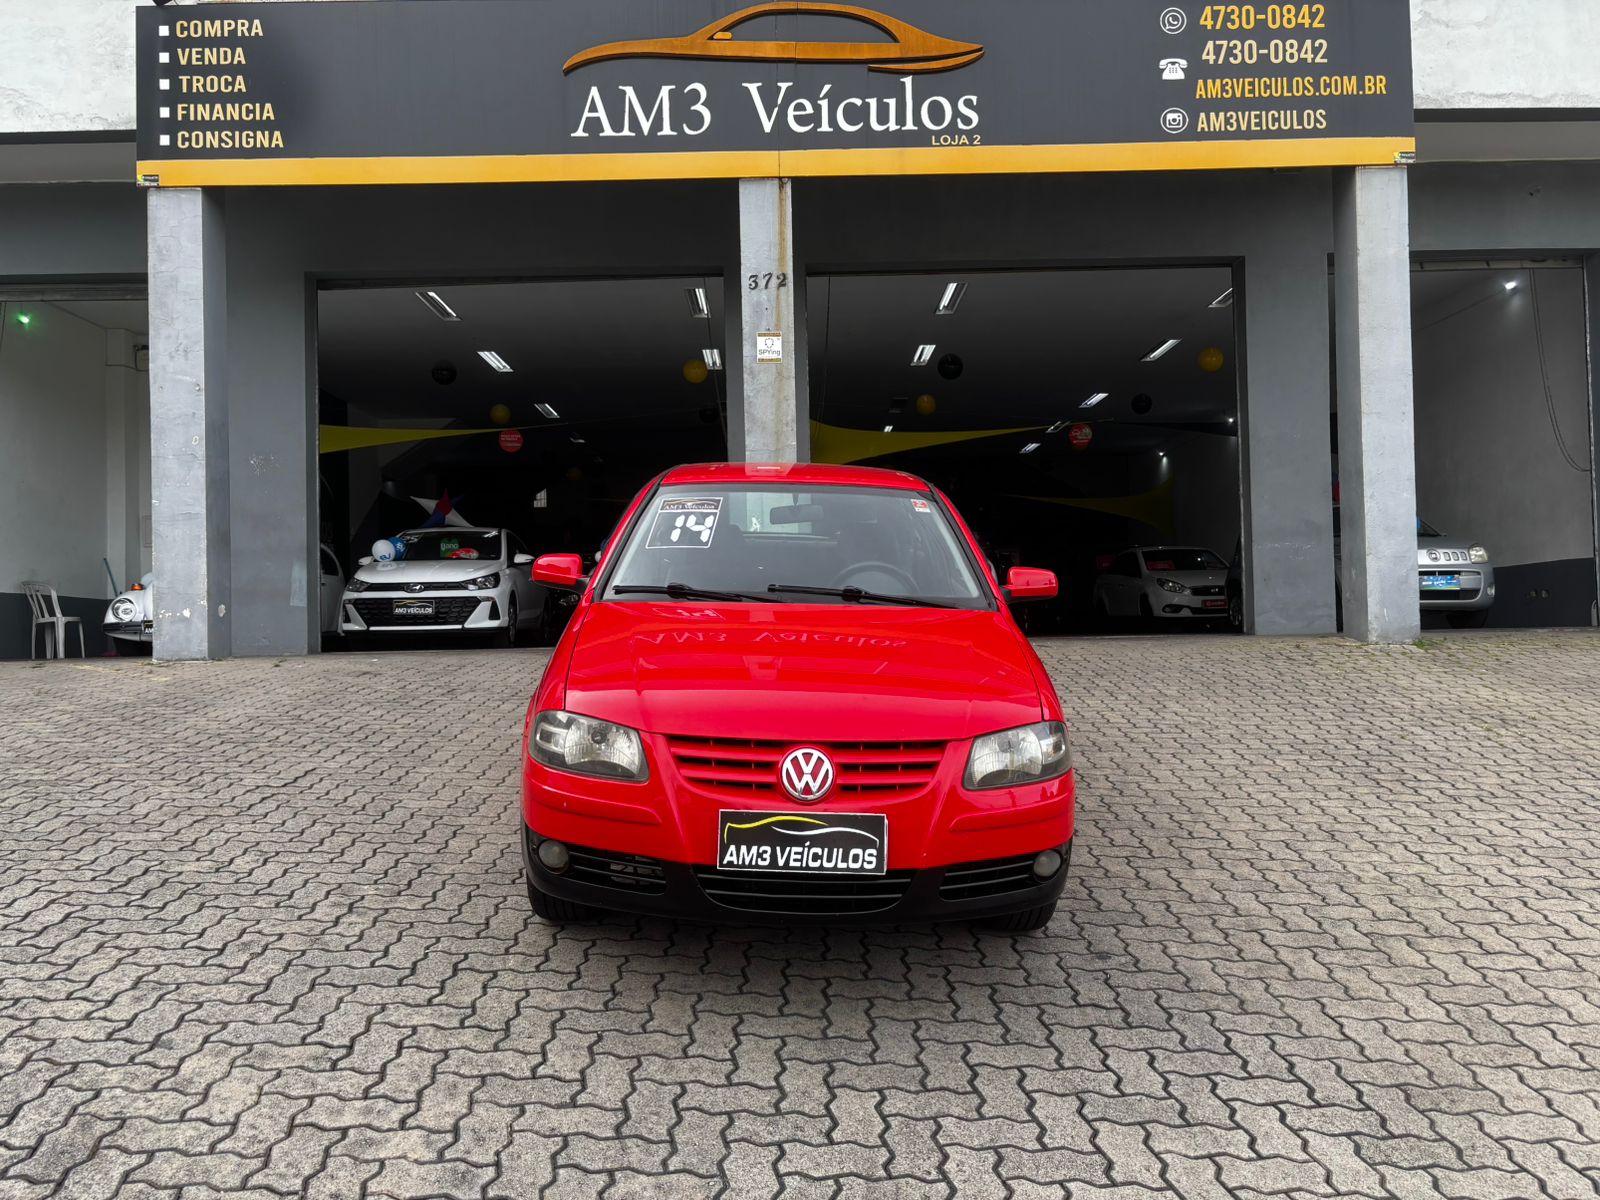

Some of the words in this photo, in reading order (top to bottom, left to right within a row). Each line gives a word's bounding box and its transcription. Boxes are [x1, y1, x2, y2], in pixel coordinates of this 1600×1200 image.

[1199, 4, 1326, 30] 4730-0842
[176, 19, 264, 38] COMPRA
[177, 47, 246, 66] VENDA
[1201, 39, 1328, 65] 4730-0842
[179, 75, 247, 93] TROCA
[1195, 75, 1387, 99] AM3VEICULOS.COM.BR
[177, 103, 275, 121] FINANCIA
[571, 82, 712, 137] AM3
[742, 75, 980, 134] Veículos
[1197, 109, 1327, 132] AM3VEICULOS
[177, 130, 284, 149] CONSIGNA
[932, 135, 969, 146] LOJA
[972, 134, 981, 145] 2
[748, 272, 788, 291] 372
[670, 514, 714, 543] 14
[723, 844, 772, 866] AM3
[776, 841, 878, 869] VEÍCULOS
